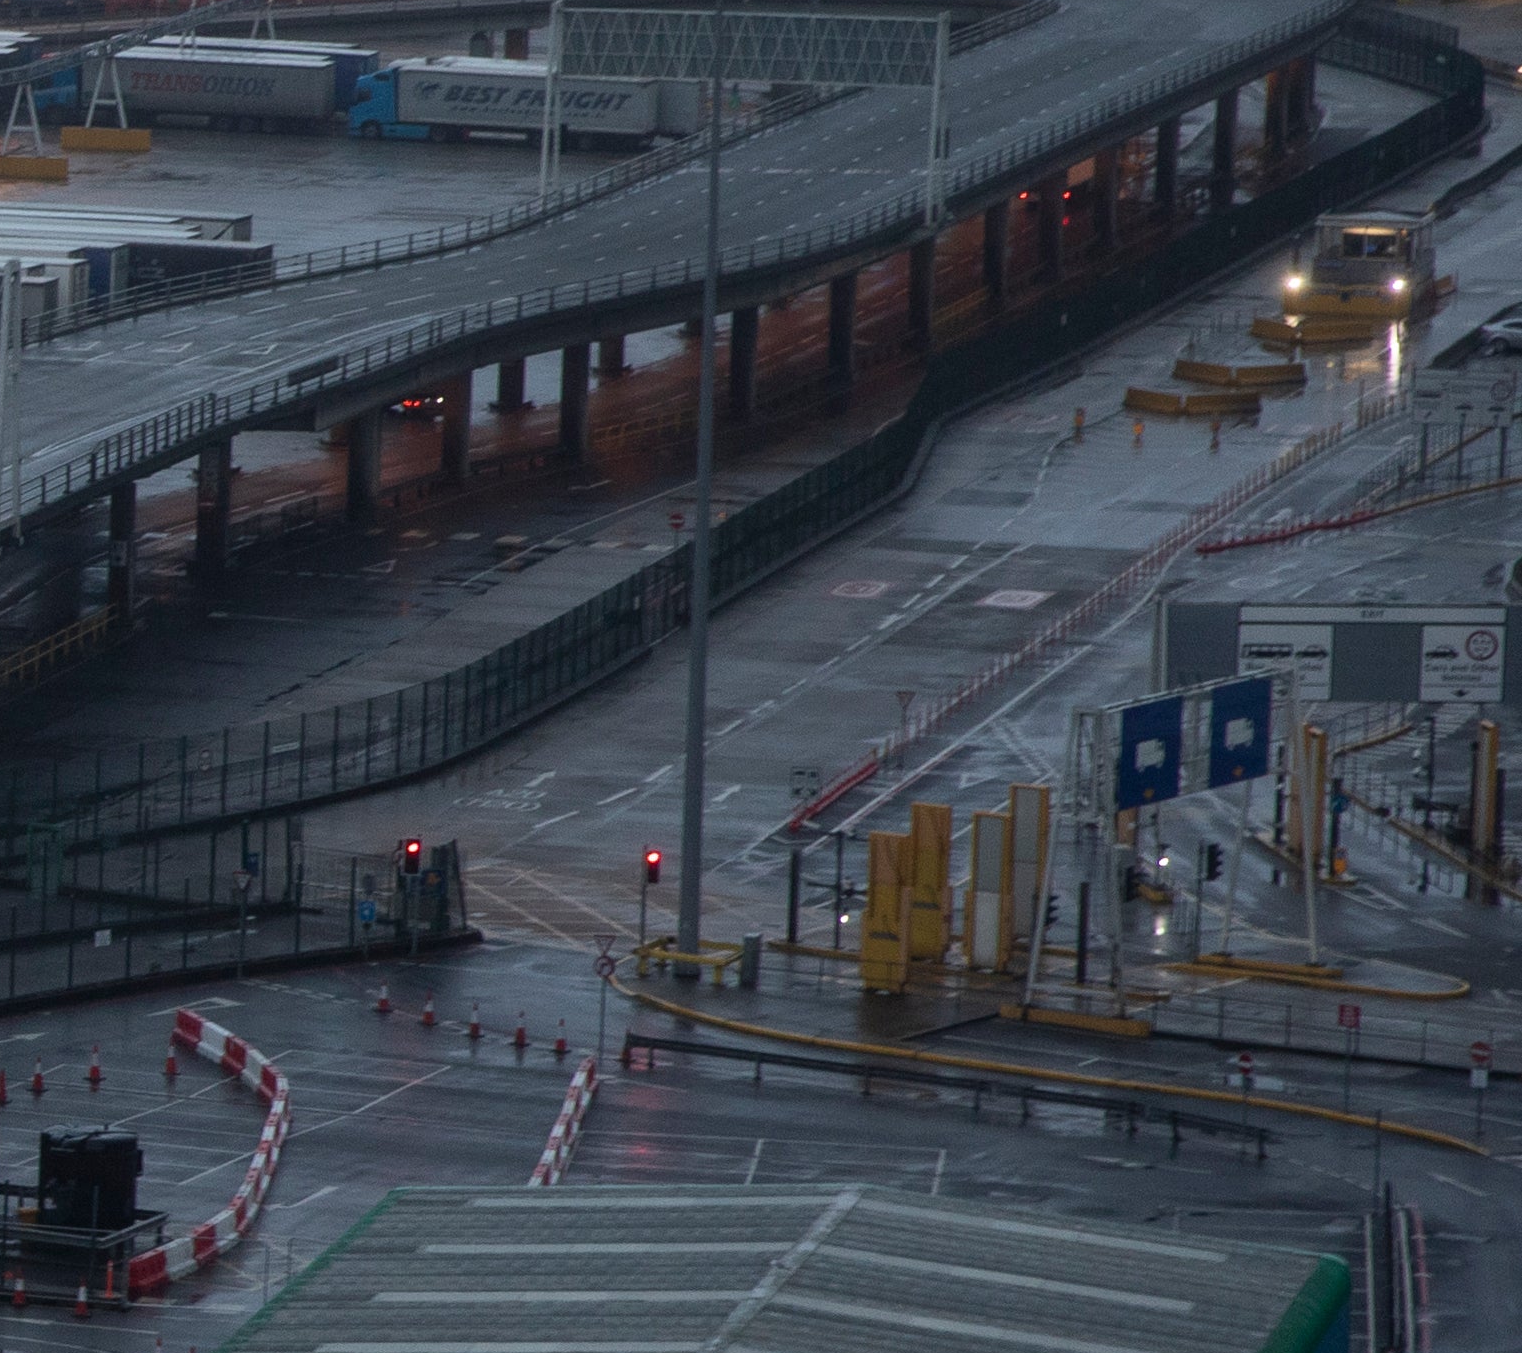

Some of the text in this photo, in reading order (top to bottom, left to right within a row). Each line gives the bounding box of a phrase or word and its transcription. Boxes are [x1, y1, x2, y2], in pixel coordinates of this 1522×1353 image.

[131, 72, 276, 96] TRANSORION
[444, 83, 632, 112] BEST FRIGHT
